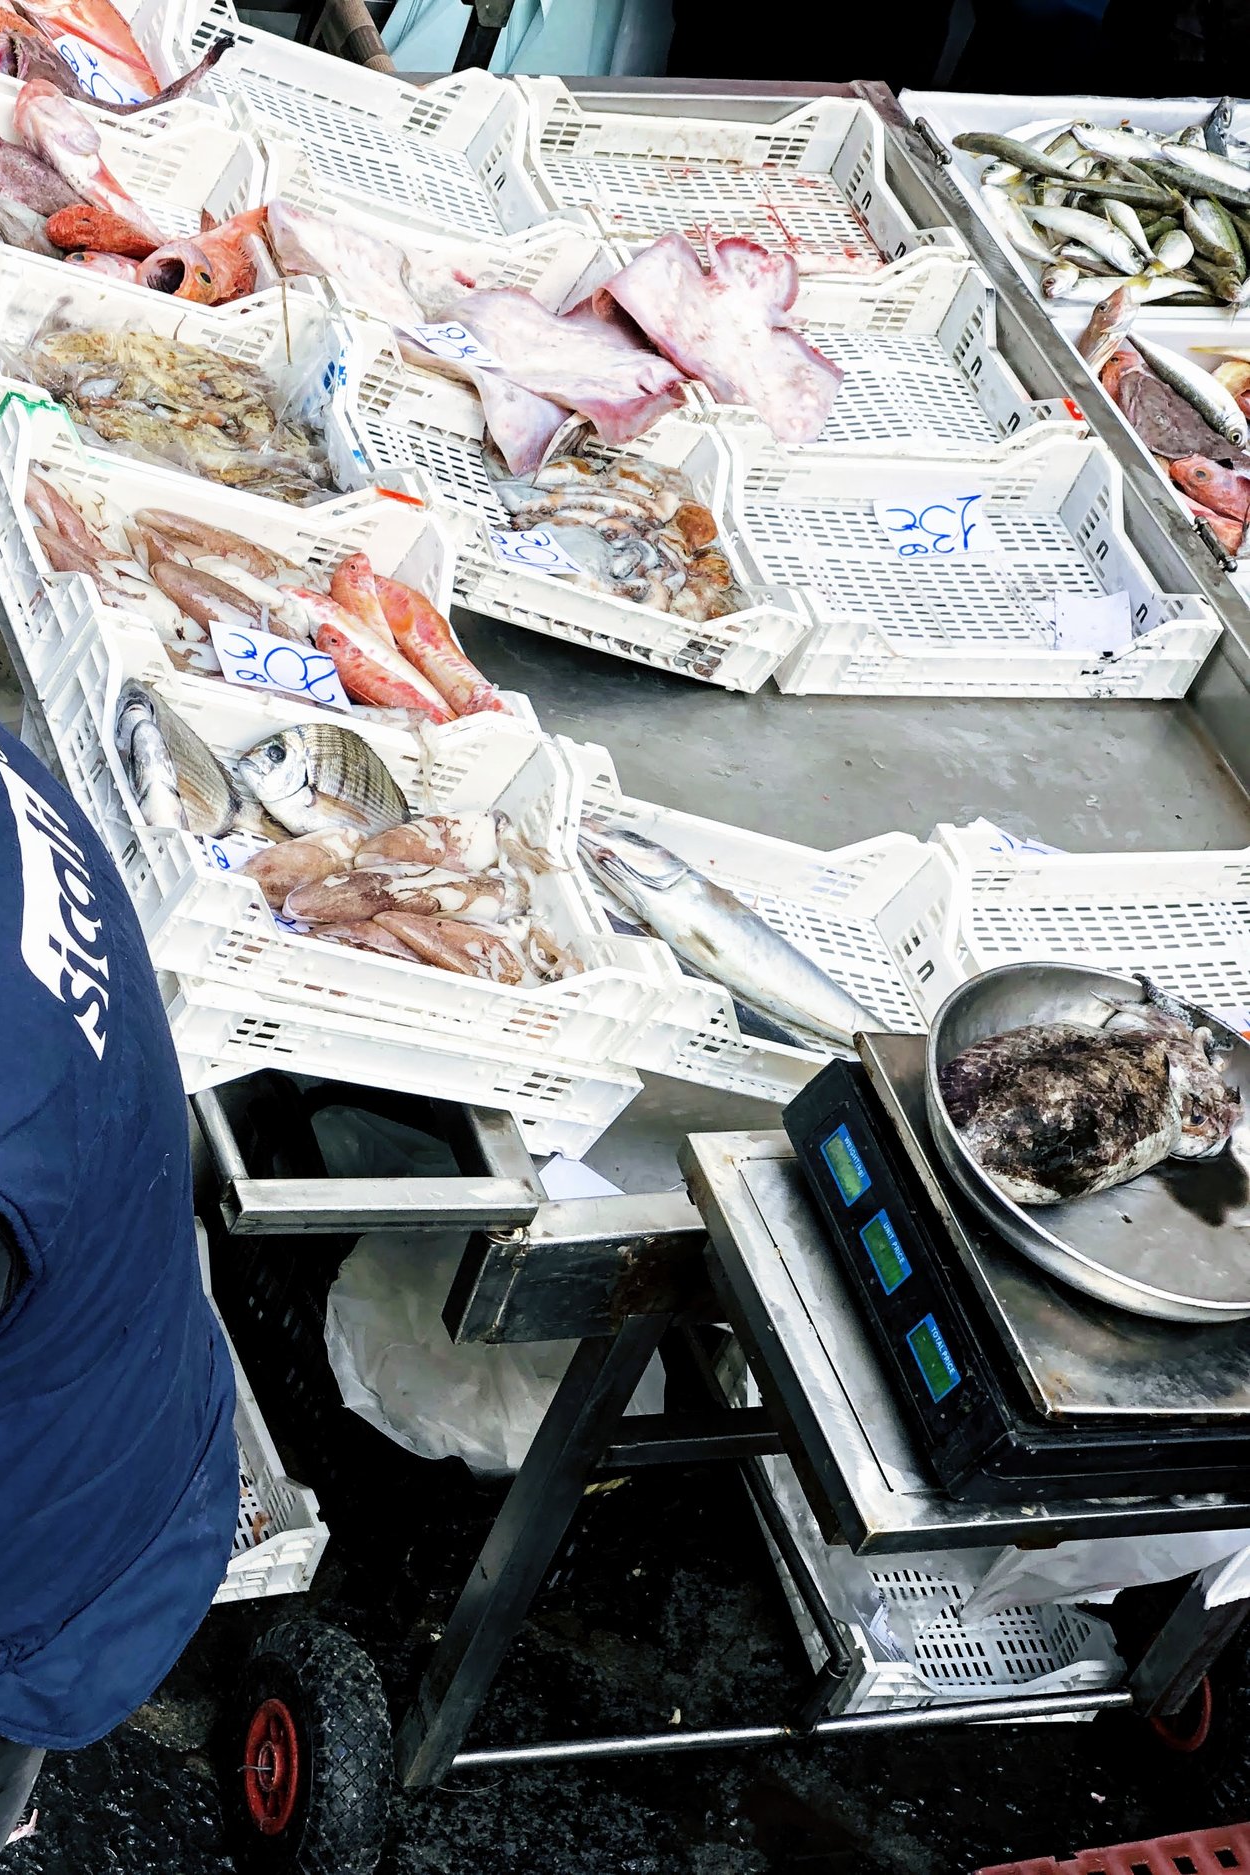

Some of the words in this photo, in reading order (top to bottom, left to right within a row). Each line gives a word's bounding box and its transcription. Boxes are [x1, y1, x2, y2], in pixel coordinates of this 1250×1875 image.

[882, 1221, 895, 1240] UNIT
[891, 1240, 906, 1265] PRICE
[931, 1326, 945, 1352] TOTAL
[941, 1350, 956, 1375] PRICE
